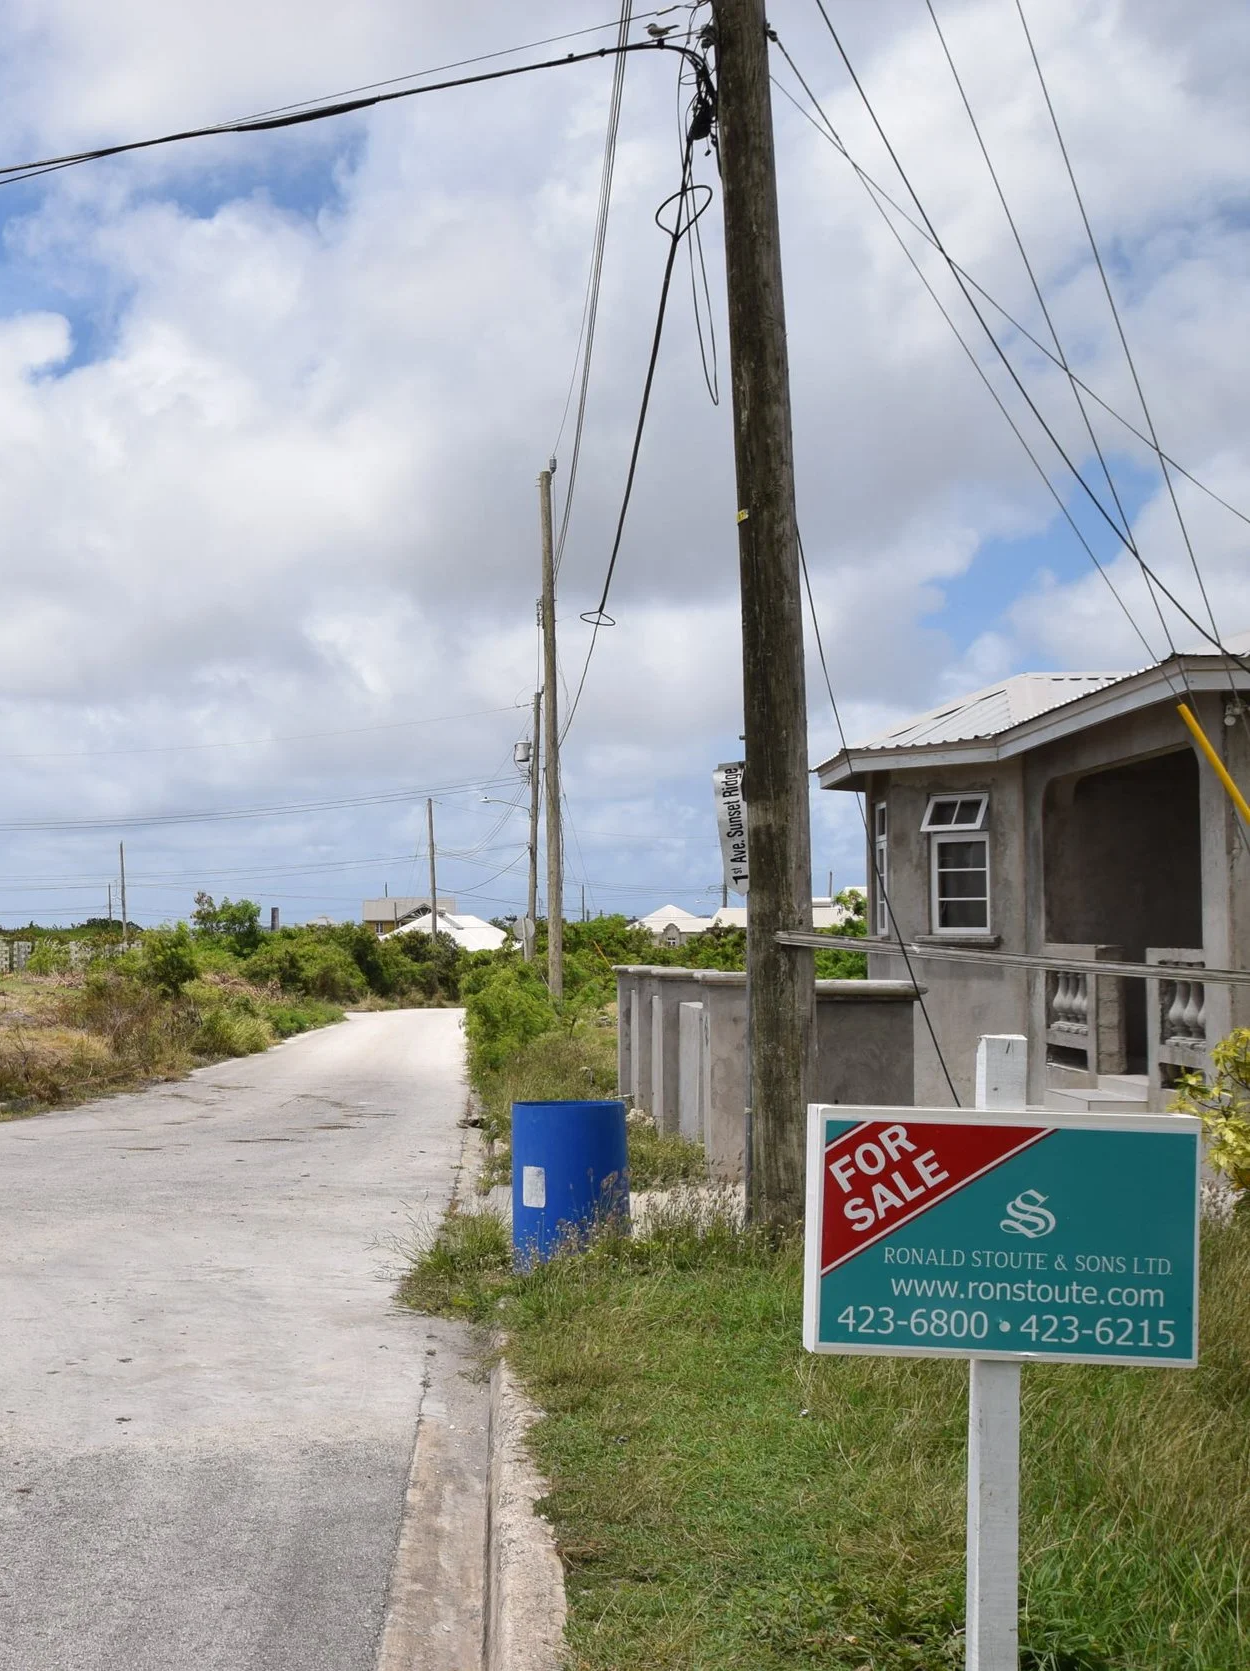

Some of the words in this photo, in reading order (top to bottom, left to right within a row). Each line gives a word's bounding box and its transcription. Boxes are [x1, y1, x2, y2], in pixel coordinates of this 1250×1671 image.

[721, 767, 742, 798] Ridge
[723, 799, 744, 838] Sunset
[730, 840, 747, 863] Ave.
[731, 867, 749, 885] 1st
[829, 1124, 917, 1193] FOR
[843, 1149, 950, 1232] SALE
[884, 1247, 965, 1267] RONALD
[971, 1250, 1047, 1270] STOUTE
[1054, 1254, 1068, 1271] &
[1075, 1255, 1126, 1273] SONS
[1133, 1256, 1172, 1275] LTD.
[891, 1277, 1164, 1307] www.ronstoute.com
[837, 1306, 988, 1338] 423-6800
[1020, 1314, 1175, 1348] 423-6215
